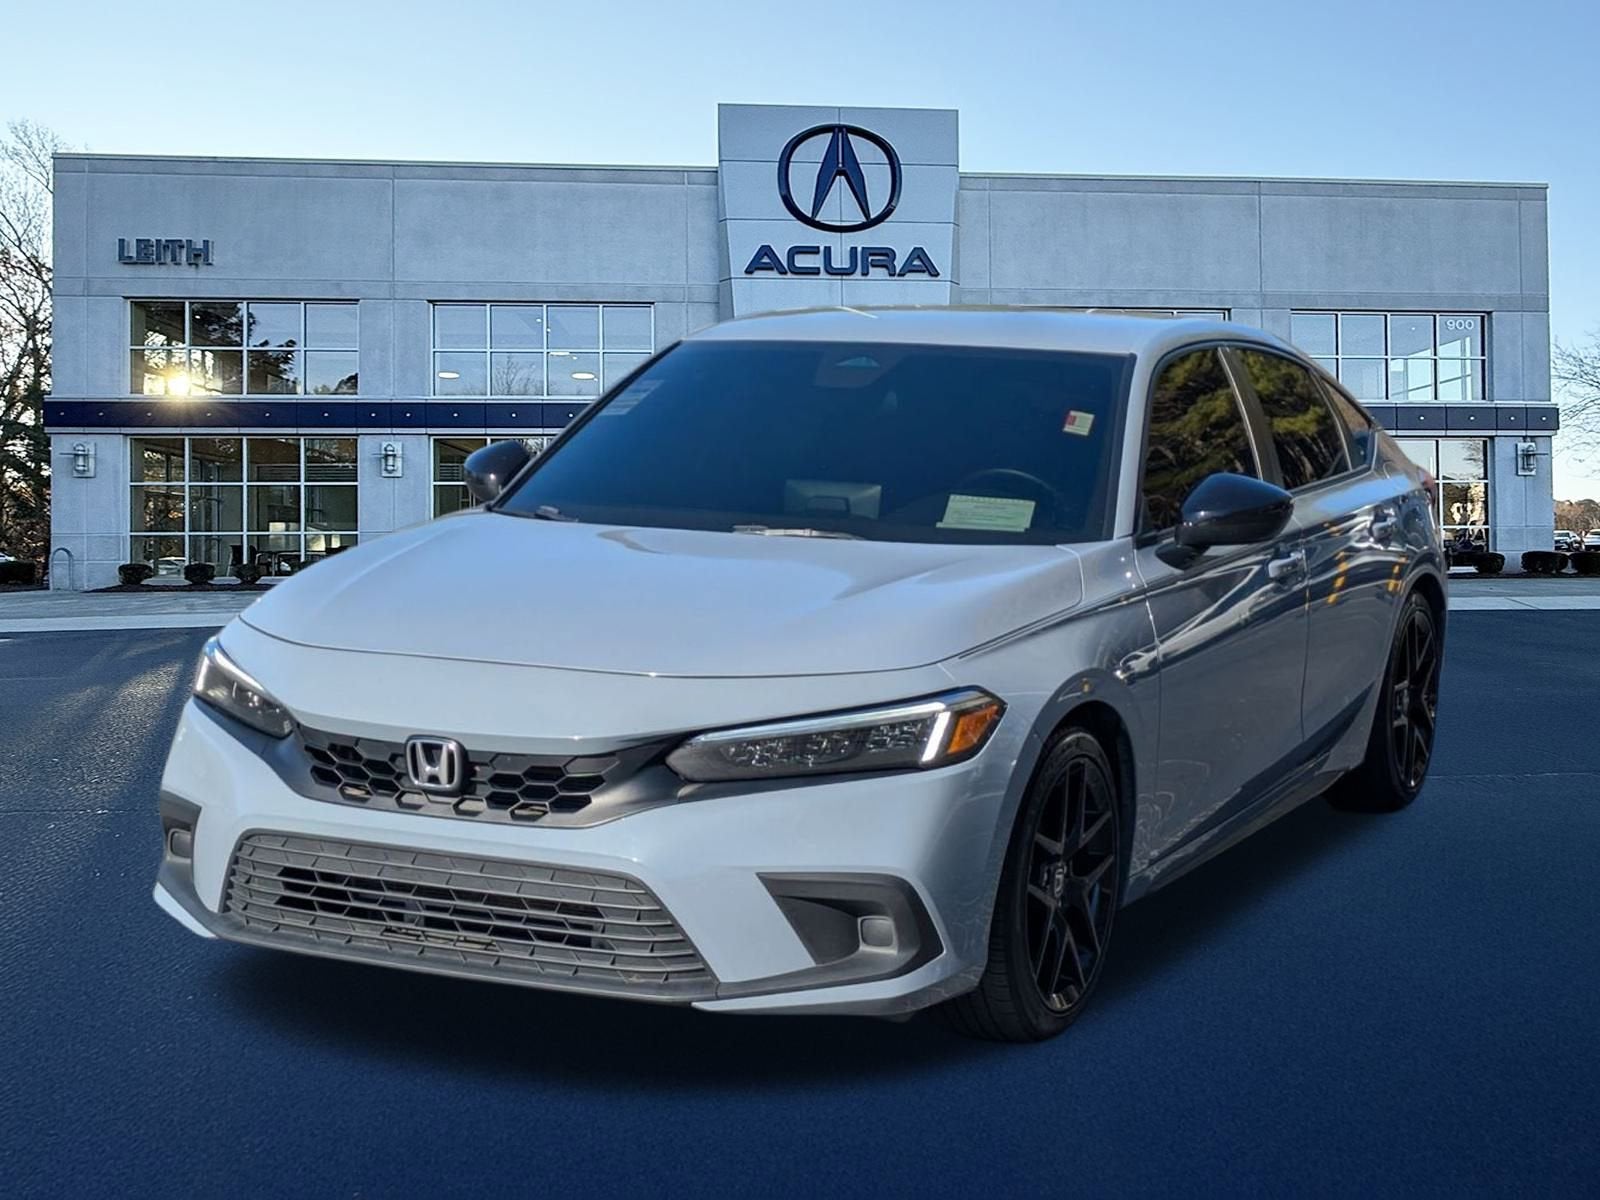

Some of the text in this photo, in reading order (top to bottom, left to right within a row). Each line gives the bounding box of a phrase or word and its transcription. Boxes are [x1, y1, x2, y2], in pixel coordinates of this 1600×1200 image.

[118, 238, 213, 265] LEITH
[744, 244, 940, 277] ACURA
[1446, 319, 1474, 330] 900
